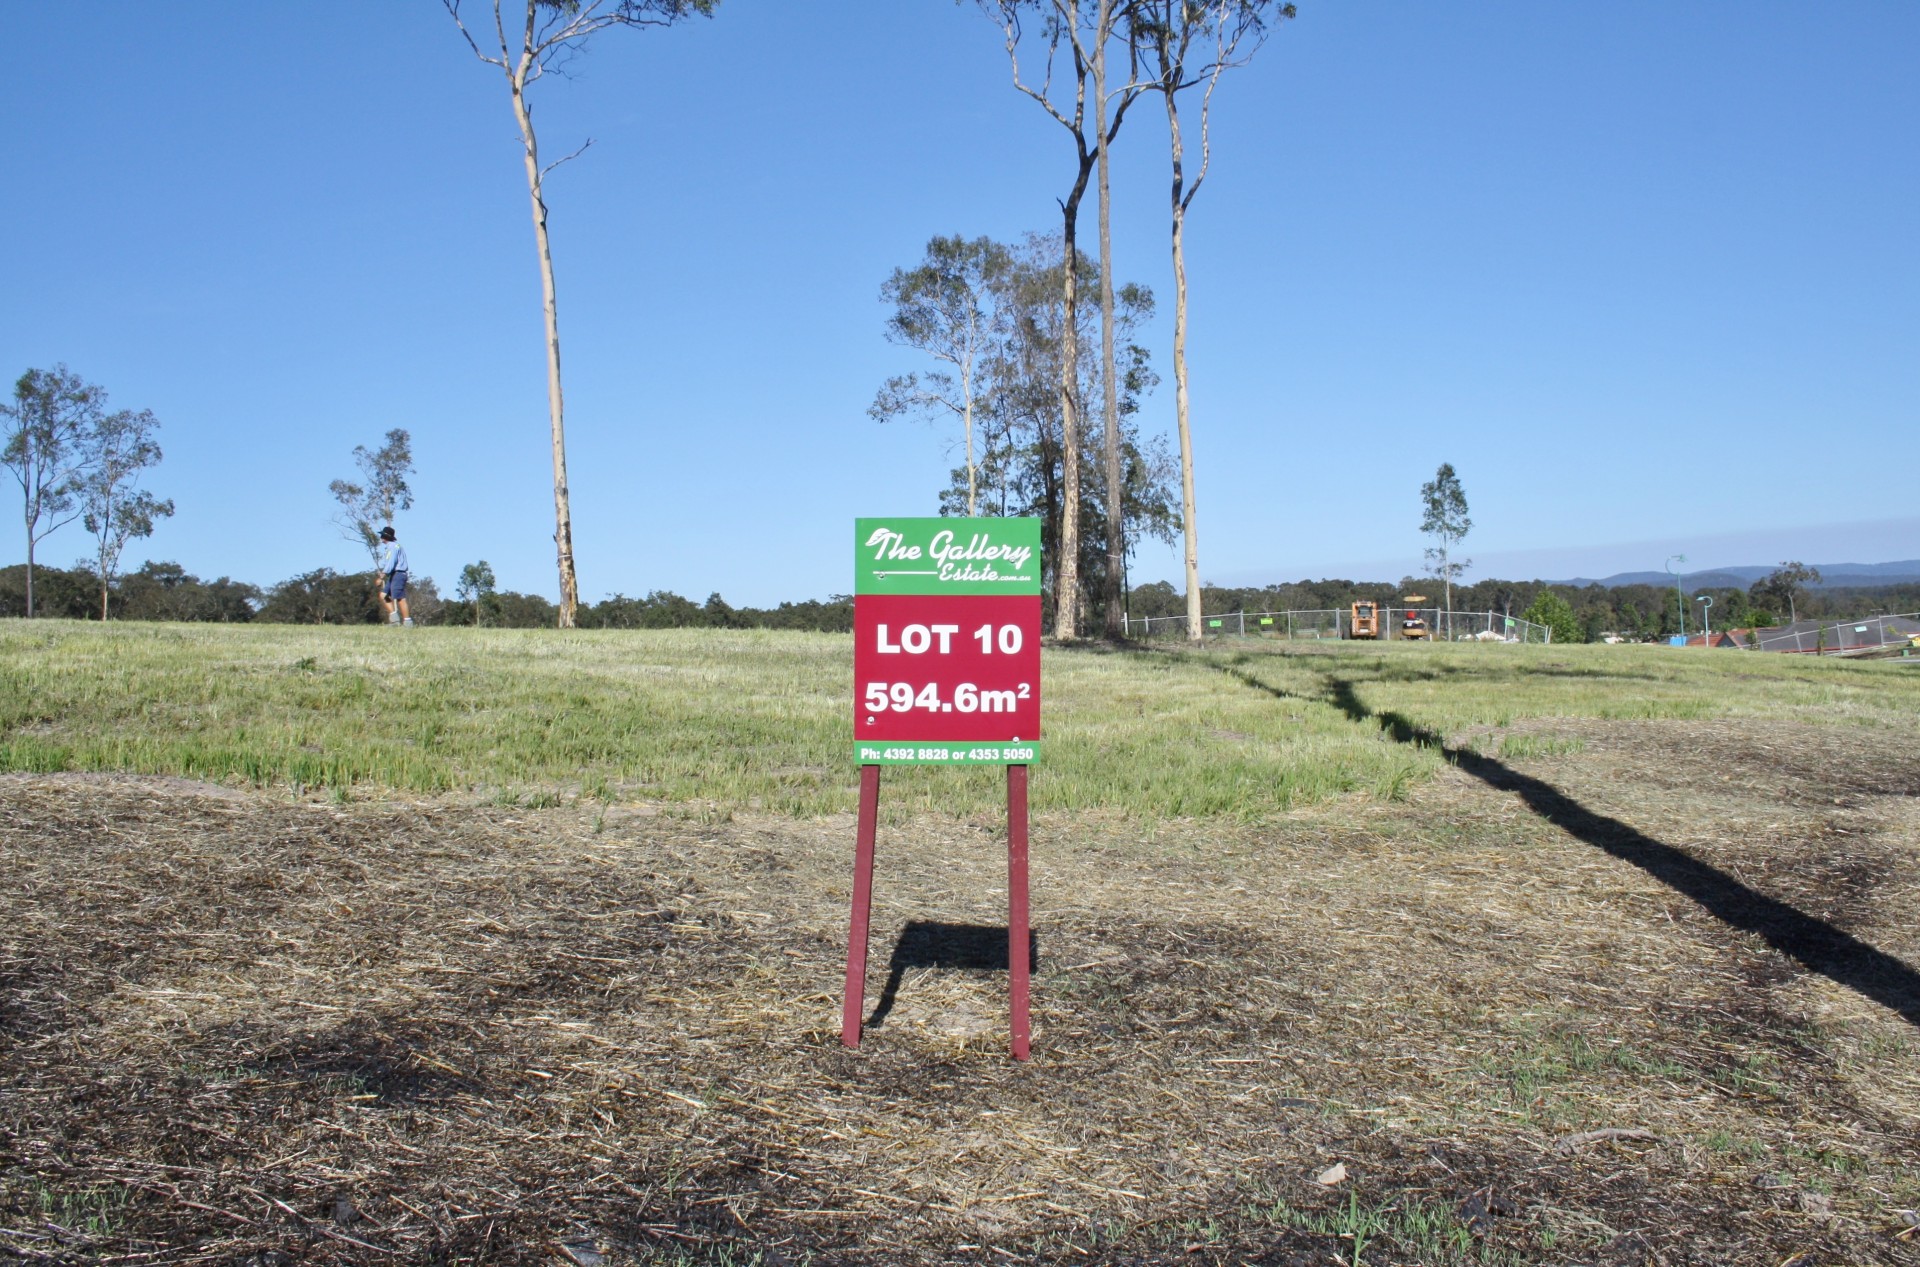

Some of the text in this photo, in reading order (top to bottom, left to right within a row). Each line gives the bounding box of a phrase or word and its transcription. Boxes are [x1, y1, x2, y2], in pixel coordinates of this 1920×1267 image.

[865, 527, 1031, 569] The Gallery
[877, 624, 1023, 655] LOT 10
[860, 748, 1034, 760] Ph: 4392 8828 or 4353 5050
